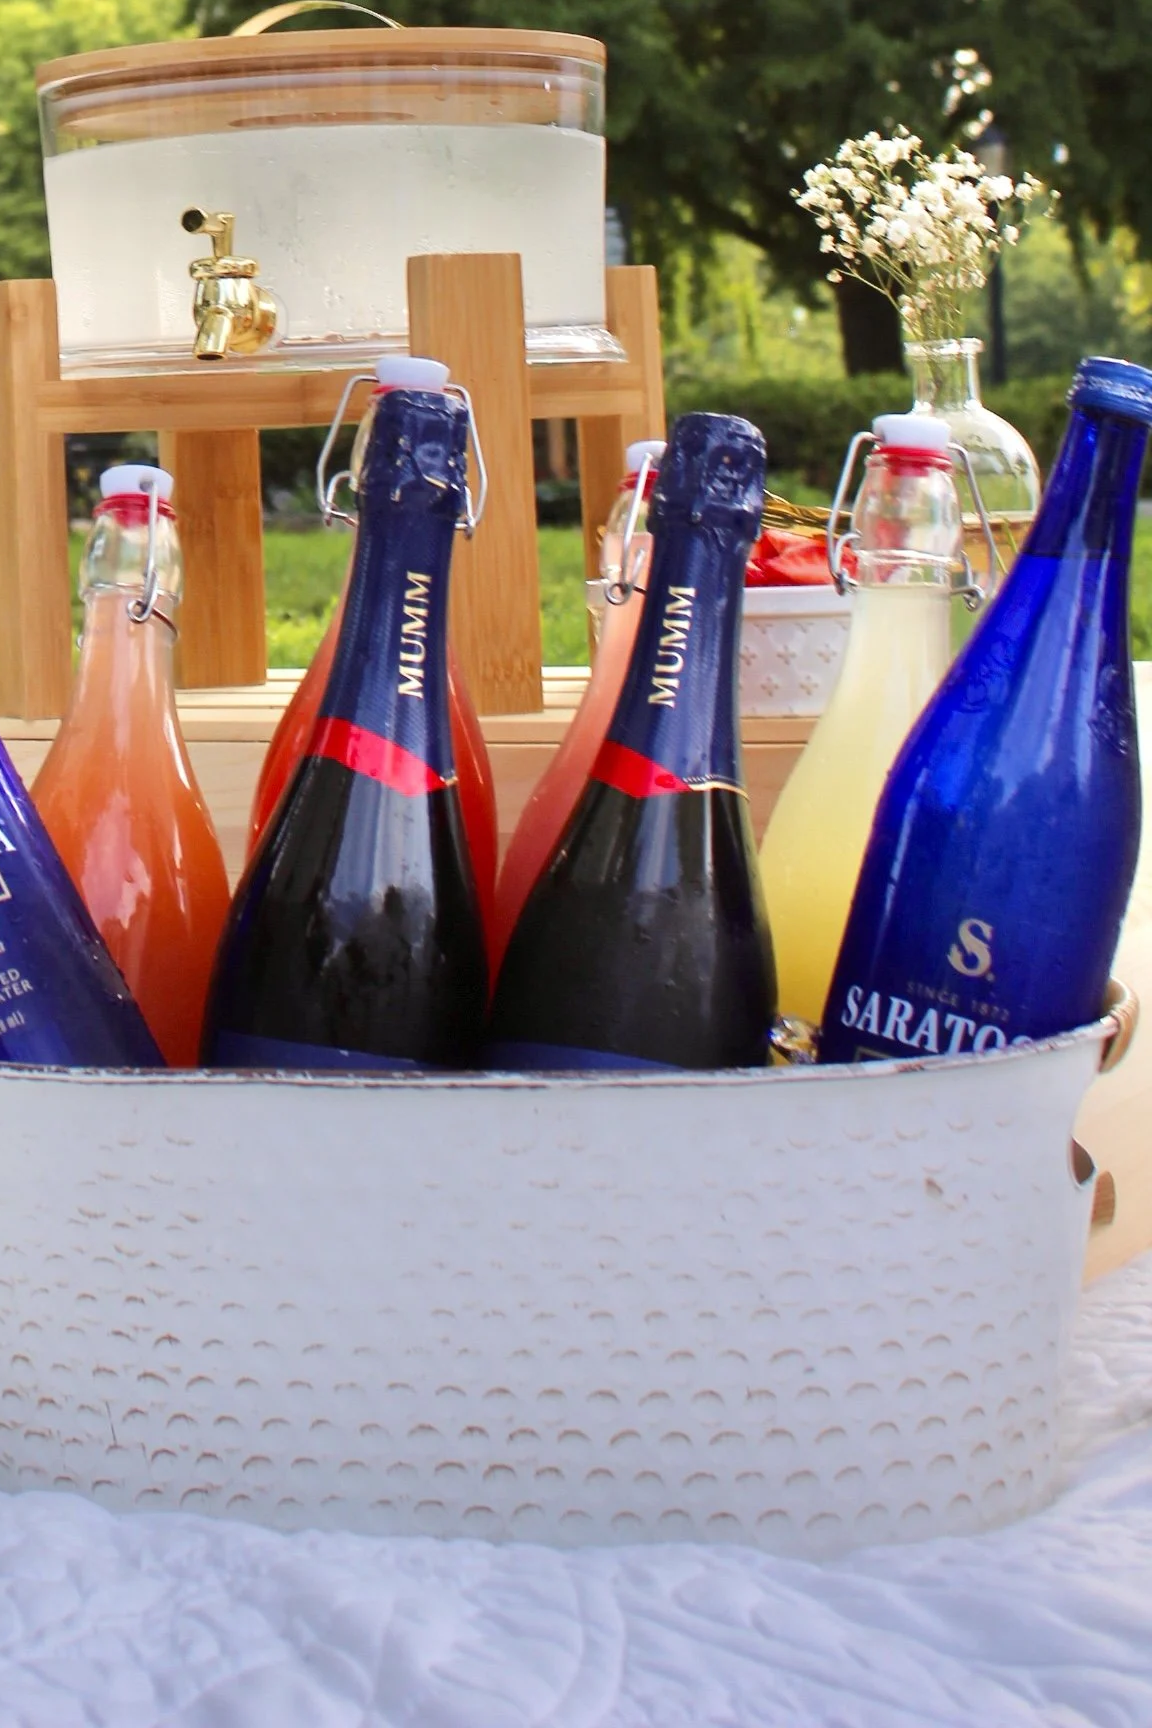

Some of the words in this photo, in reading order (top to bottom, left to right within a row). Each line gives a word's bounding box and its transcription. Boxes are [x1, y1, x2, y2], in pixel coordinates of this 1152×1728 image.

[397, 570, 432, 699] MUMM
[647, 585, 696, 708] MUMM
[840, 984, 1034, 1056] SARATO
[905, 980, 960, 1008] SINCE
[971, 999, 1011, 1022] 1872
